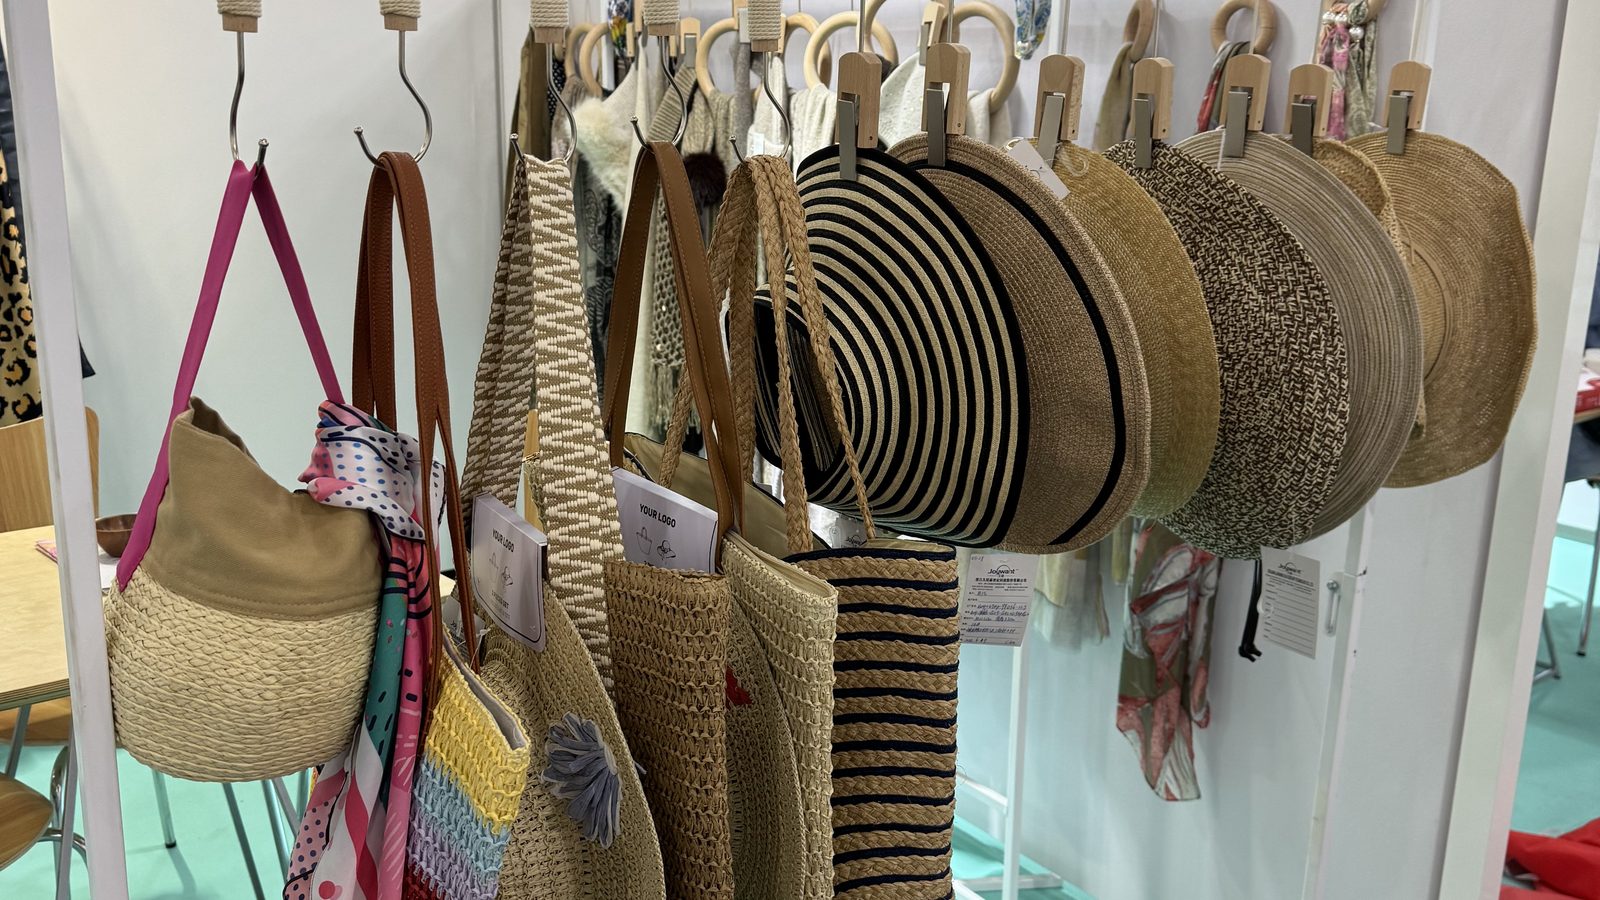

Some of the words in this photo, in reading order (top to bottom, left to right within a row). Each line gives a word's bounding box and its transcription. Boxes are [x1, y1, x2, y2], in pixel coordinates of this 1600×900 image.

[640, 503, 657, 520] YOUR
[658, 512, 676, 528] LOGO
[492, 528, 503, 545] YOUR
[502, 536, 515, 553] LOGO
